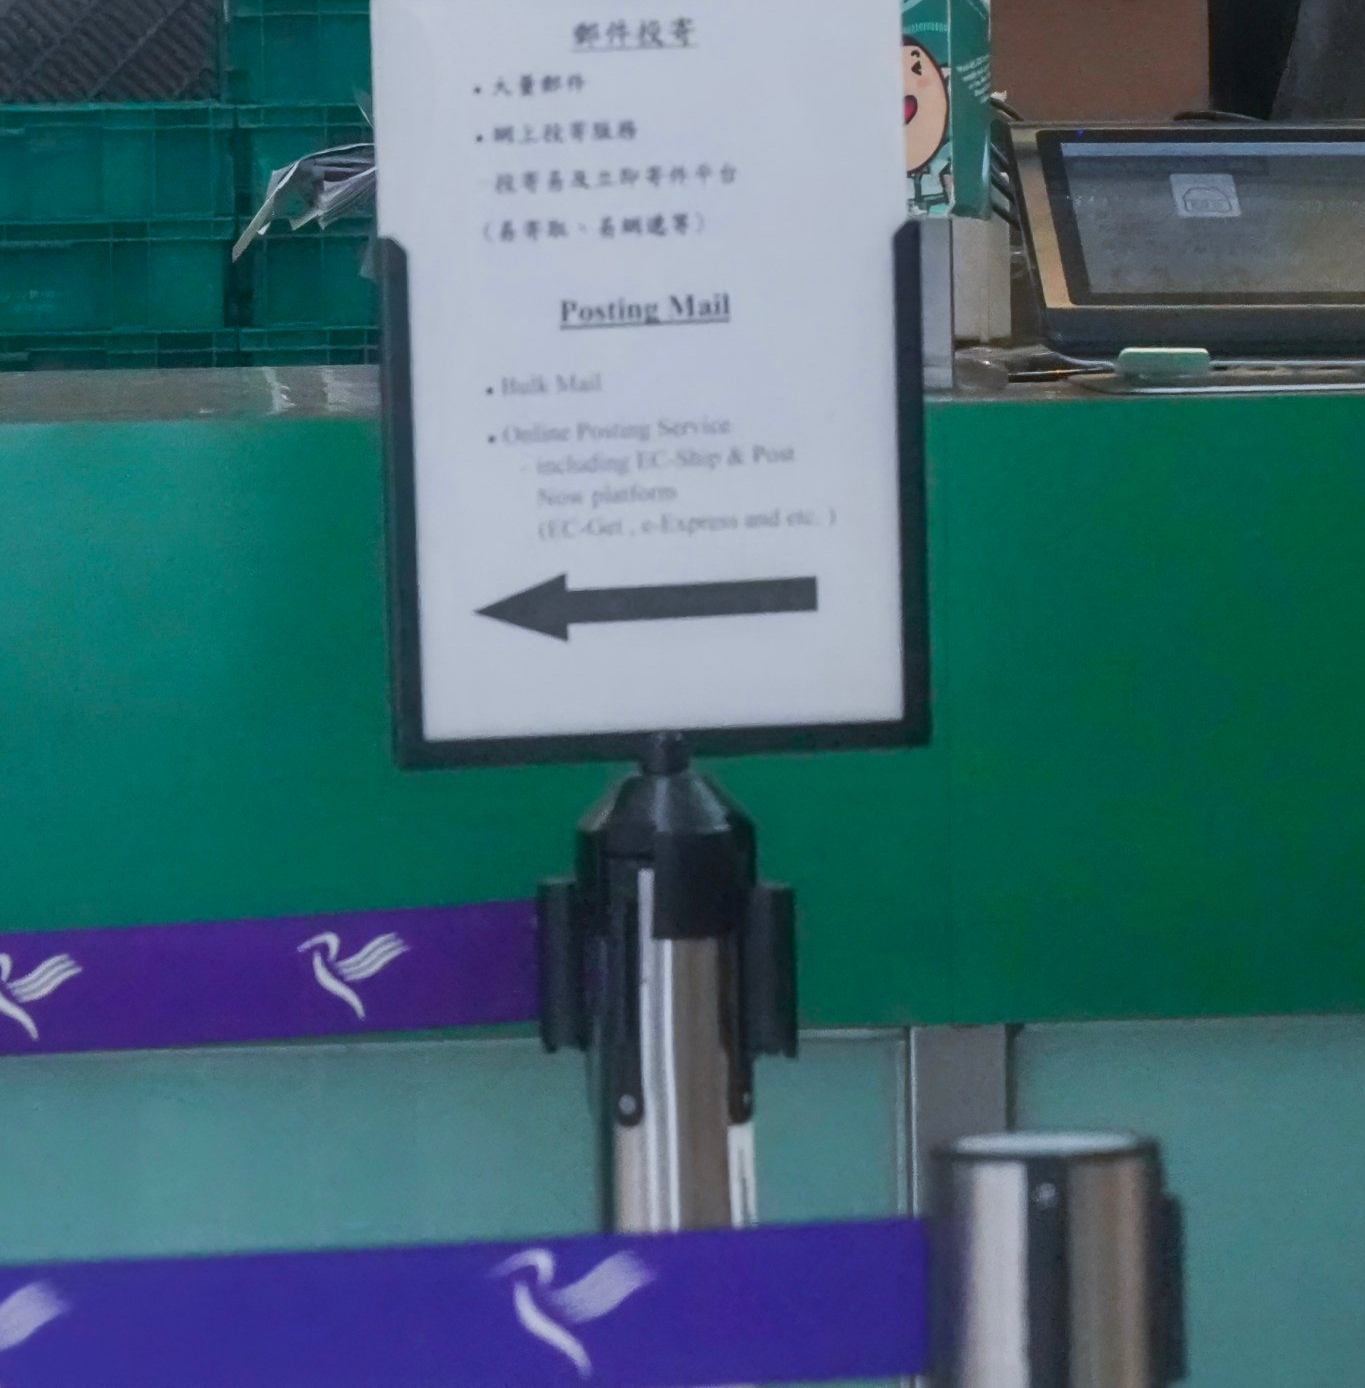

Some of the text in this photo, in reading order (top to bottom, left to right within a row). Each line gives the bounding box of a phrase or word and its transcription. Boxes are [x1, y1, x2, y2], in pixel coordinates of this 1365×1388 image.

[572, 17, 693, 48] 郵件投寄
[494, 73, 585, 96] 大量郵件
[494, 119, 637, 144] 網上投寄服務
[561, 293, 729, 325] Posting Mail
[502, 373, 602, 395] Bulk Mail
[502, 416, 731, 442] Online Posting Service
[537, 444, 794, 476] including EC-Ship & Post
[537, 483, 677, 509] Now platform
[641, 512, 738, 536] e-Express
[744, 507, 780, 527] and
